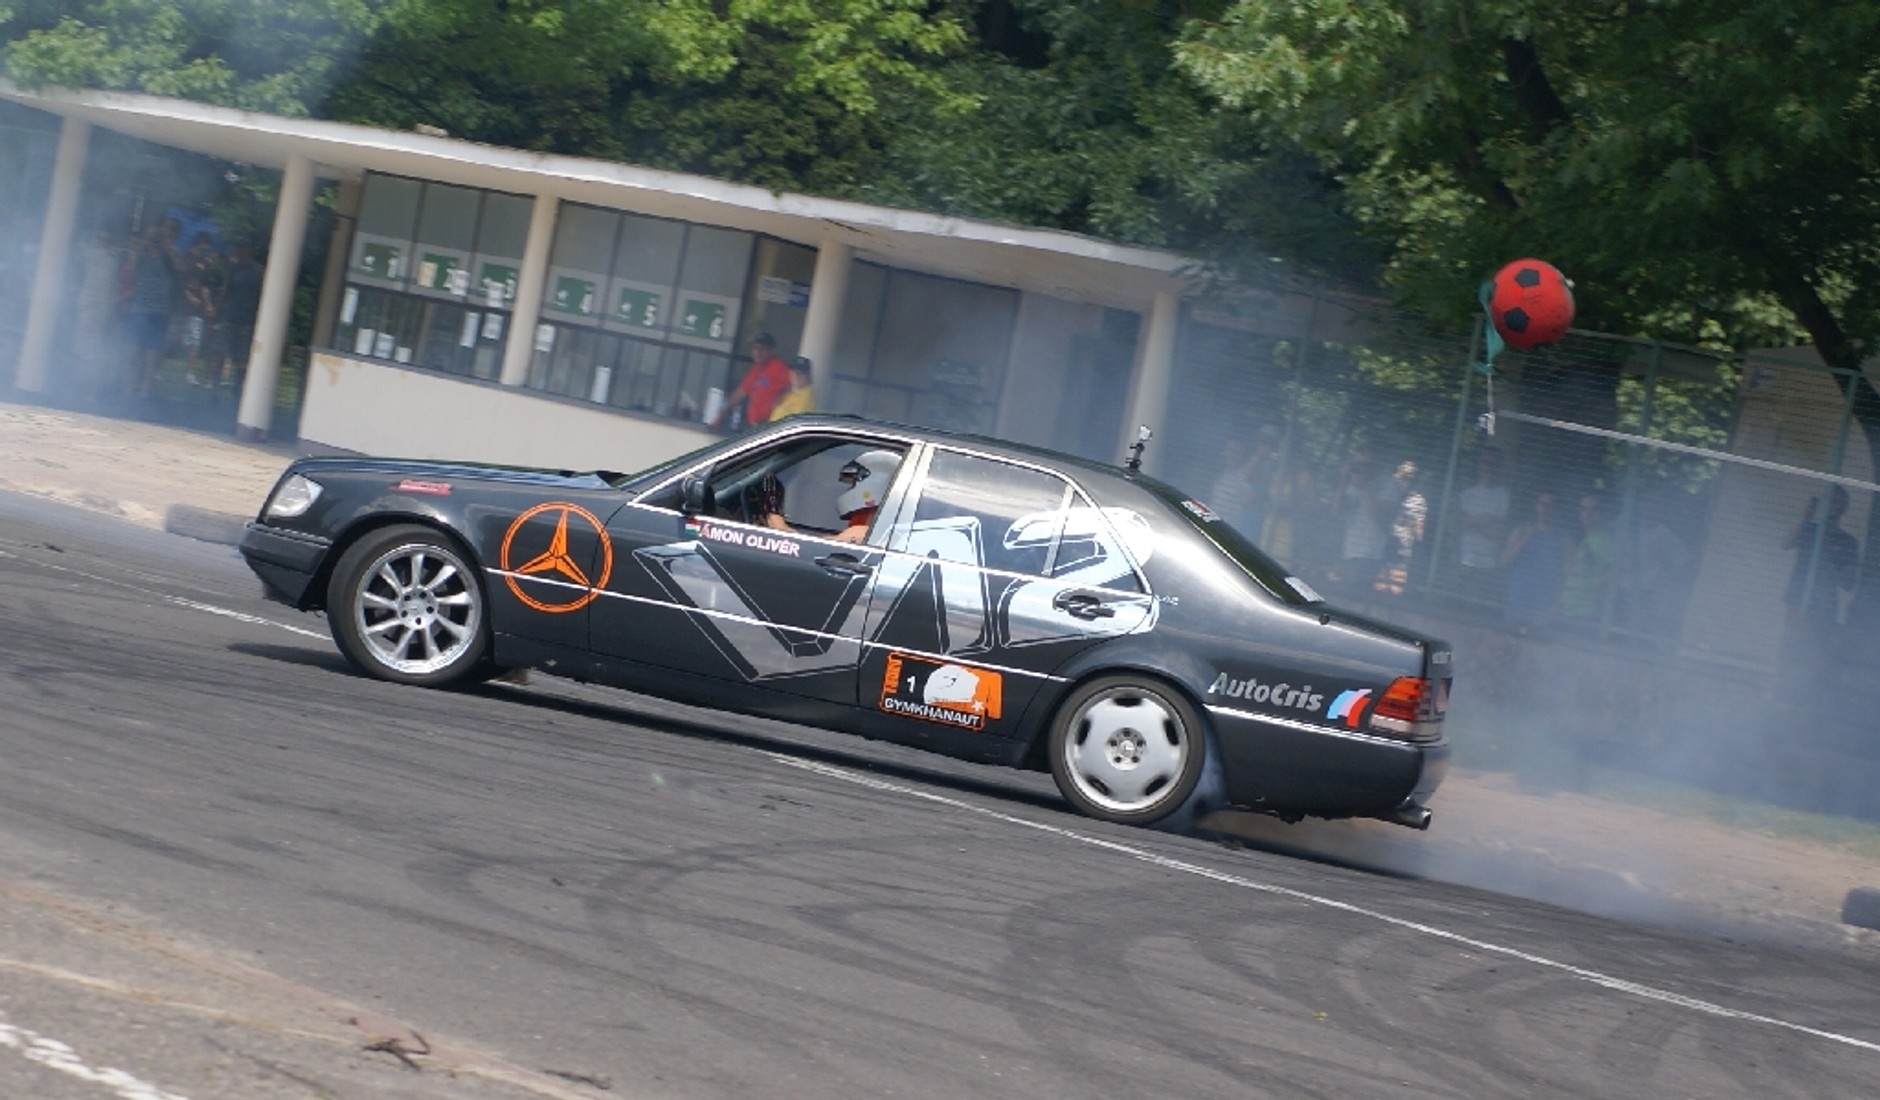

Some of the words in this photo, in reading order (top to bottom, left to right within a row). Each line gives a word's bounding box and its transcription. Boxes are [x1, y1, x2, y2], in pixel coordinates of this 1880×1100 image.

[642, 304, 657, 327] 5
[709, 316, 723, 339] 6
[906, 675, 917, 694] 1
[1207, 671, 1325, 712] AutoCris
[884, 698, 981, 726] GYMKHANAUT
